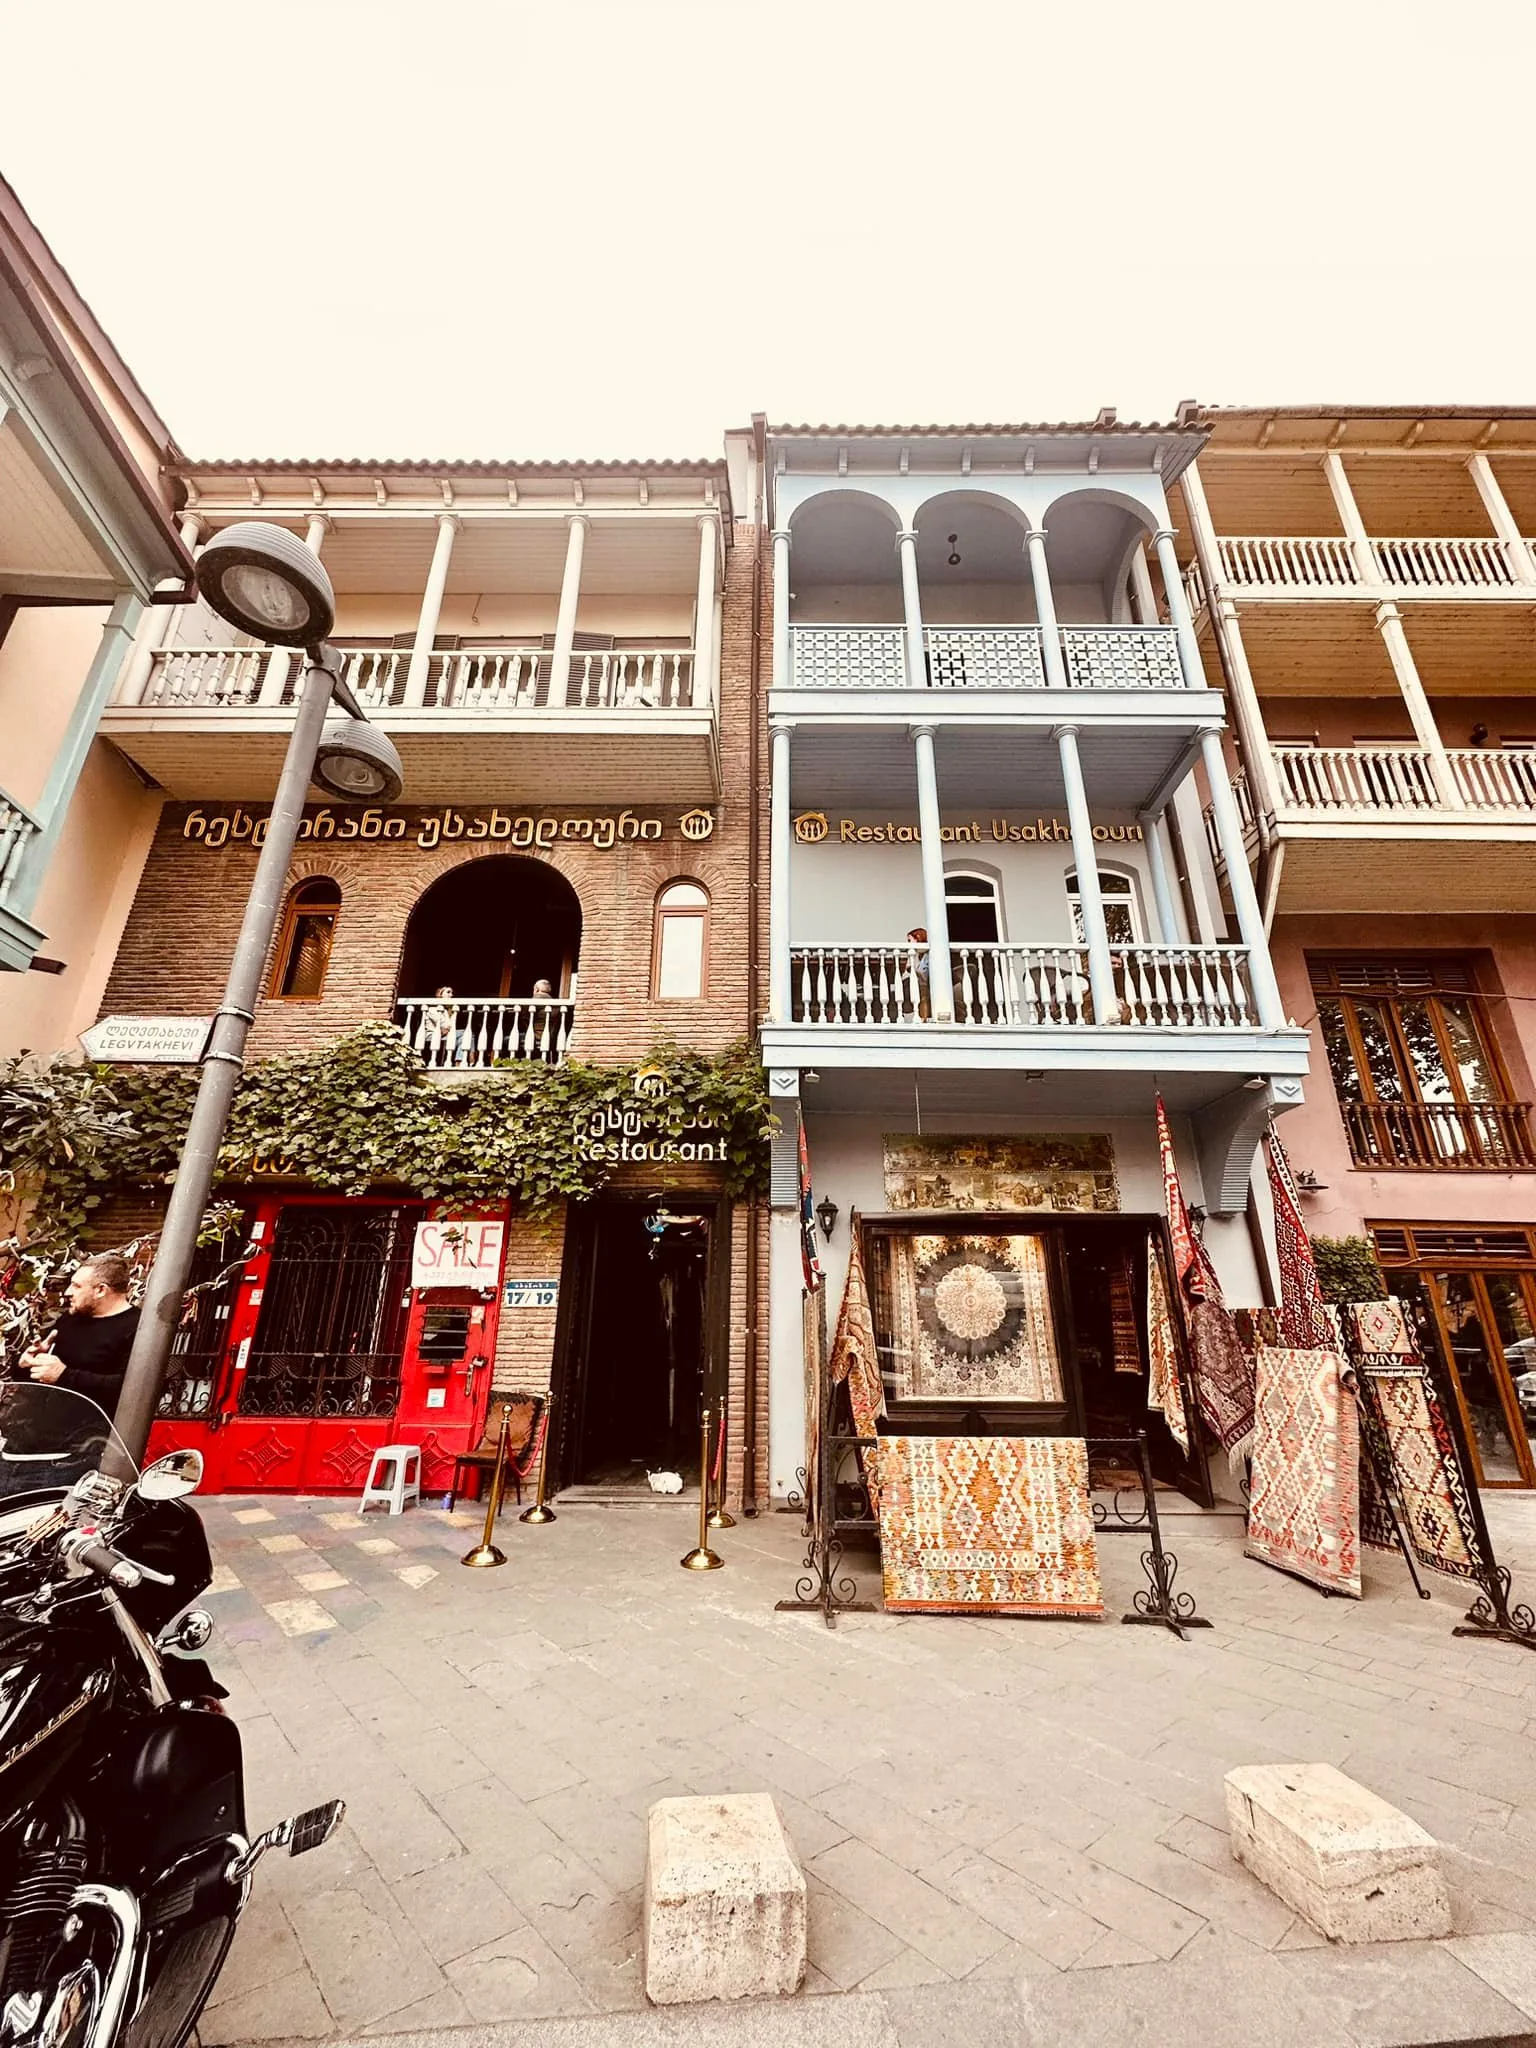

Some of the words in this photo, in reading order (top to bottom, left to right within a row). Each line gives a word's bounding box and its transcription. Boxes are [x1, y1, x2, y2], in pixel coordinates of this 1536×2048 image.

[417, 808, 662, 848] უსახელოური
[991, 818, 1143, 841] Usakhouri
[105, 1025, 200, 1038] ლეღვთახევი
[100, 1039, 194, 1050] LEGVTAKHEVI
[417, 1225, 501, 1268] SALE
